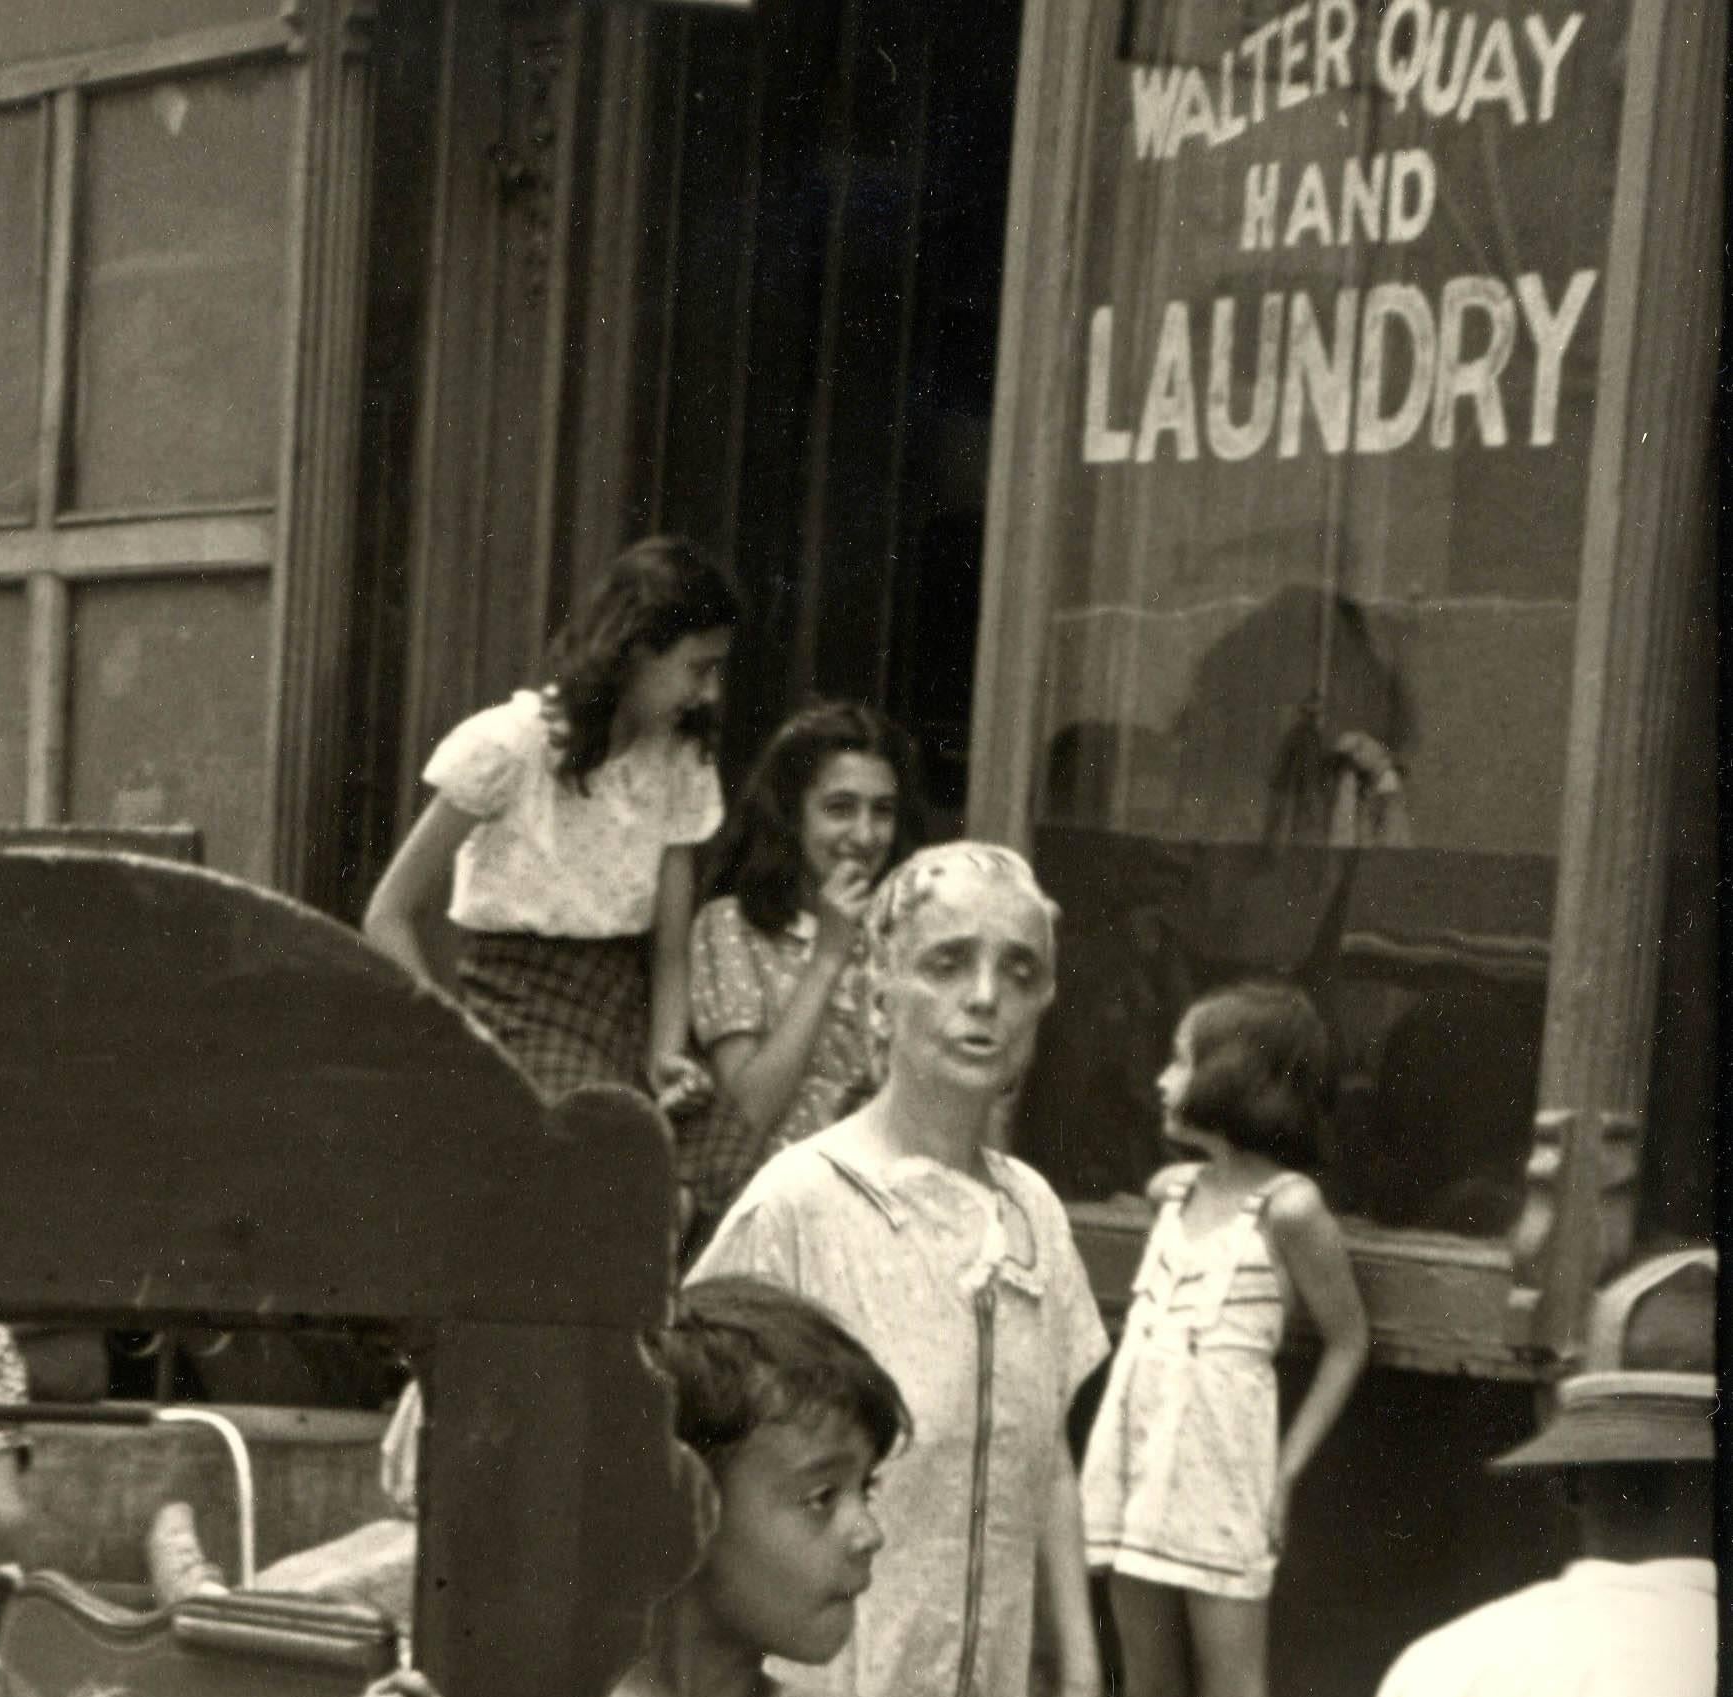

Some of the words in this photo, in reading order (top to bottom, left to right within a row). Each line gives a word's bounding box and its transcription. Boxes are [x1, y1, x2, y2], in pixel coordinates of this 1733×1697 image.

[1131, 0, 1360, 160] WALTER
[1377, 0, 1584, 127] QUAY
[1239, 148, 1438, 251] HAND
[1081, 269, 1598, 465] LAUNDRY
